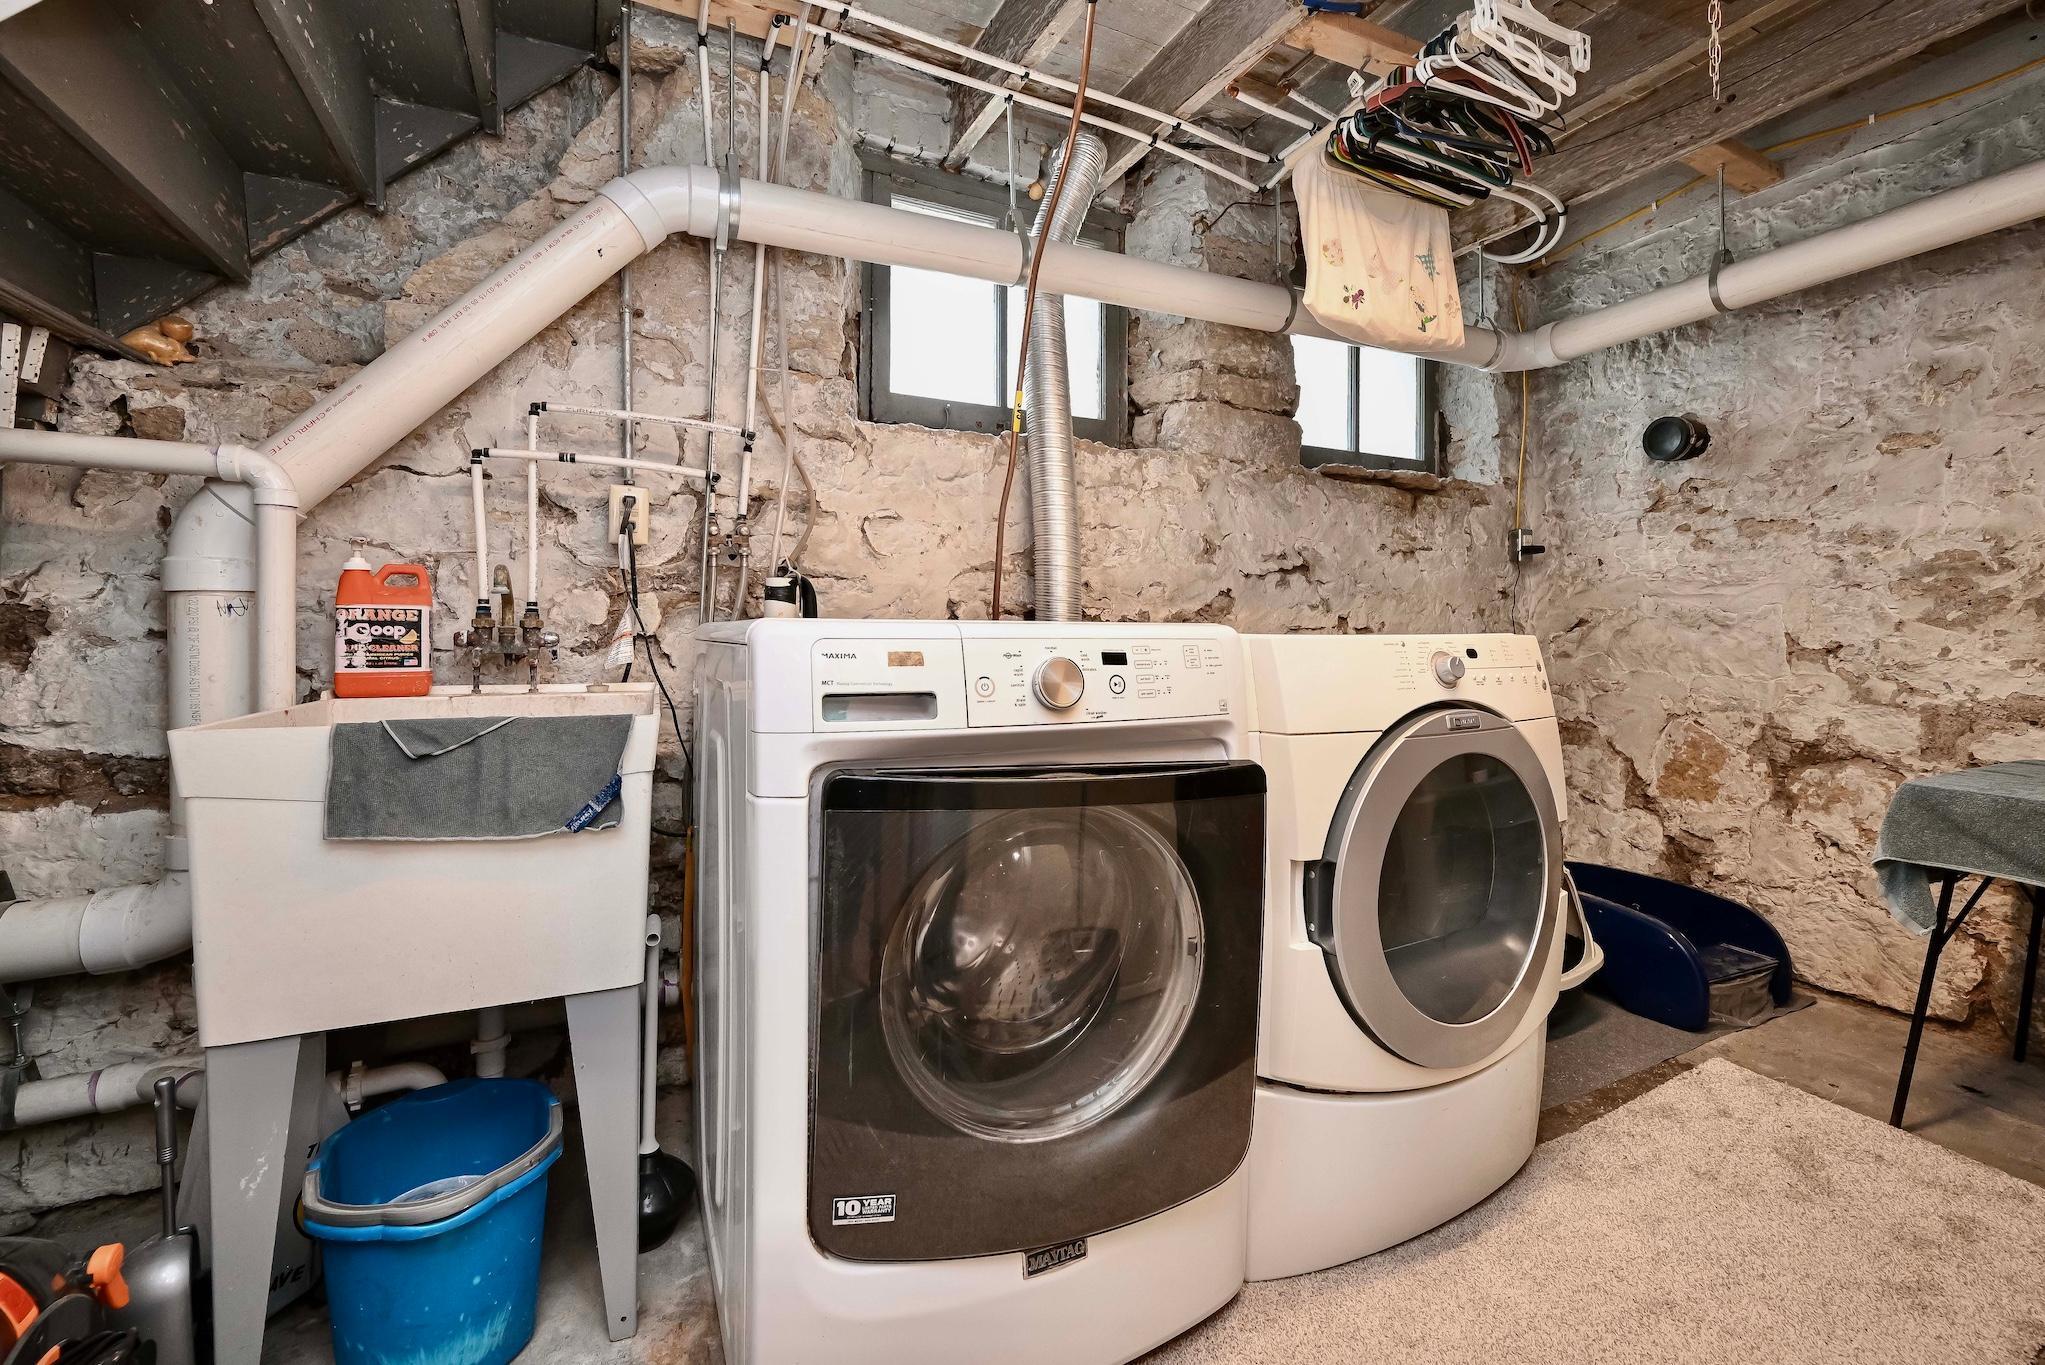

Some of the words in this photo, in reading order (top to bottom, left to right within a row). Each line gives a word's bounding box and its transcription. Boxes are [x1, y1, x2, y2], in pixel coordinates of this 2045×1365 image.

[336, 608, 419, 622] ORANGE
[369, 644, 418, 652] CLEANER
[837, 1200, 861, 1217] 10
[863, 1198, 892, 1207] YEAR
[1029, 1241, 1085, 1271] MAYTAG
